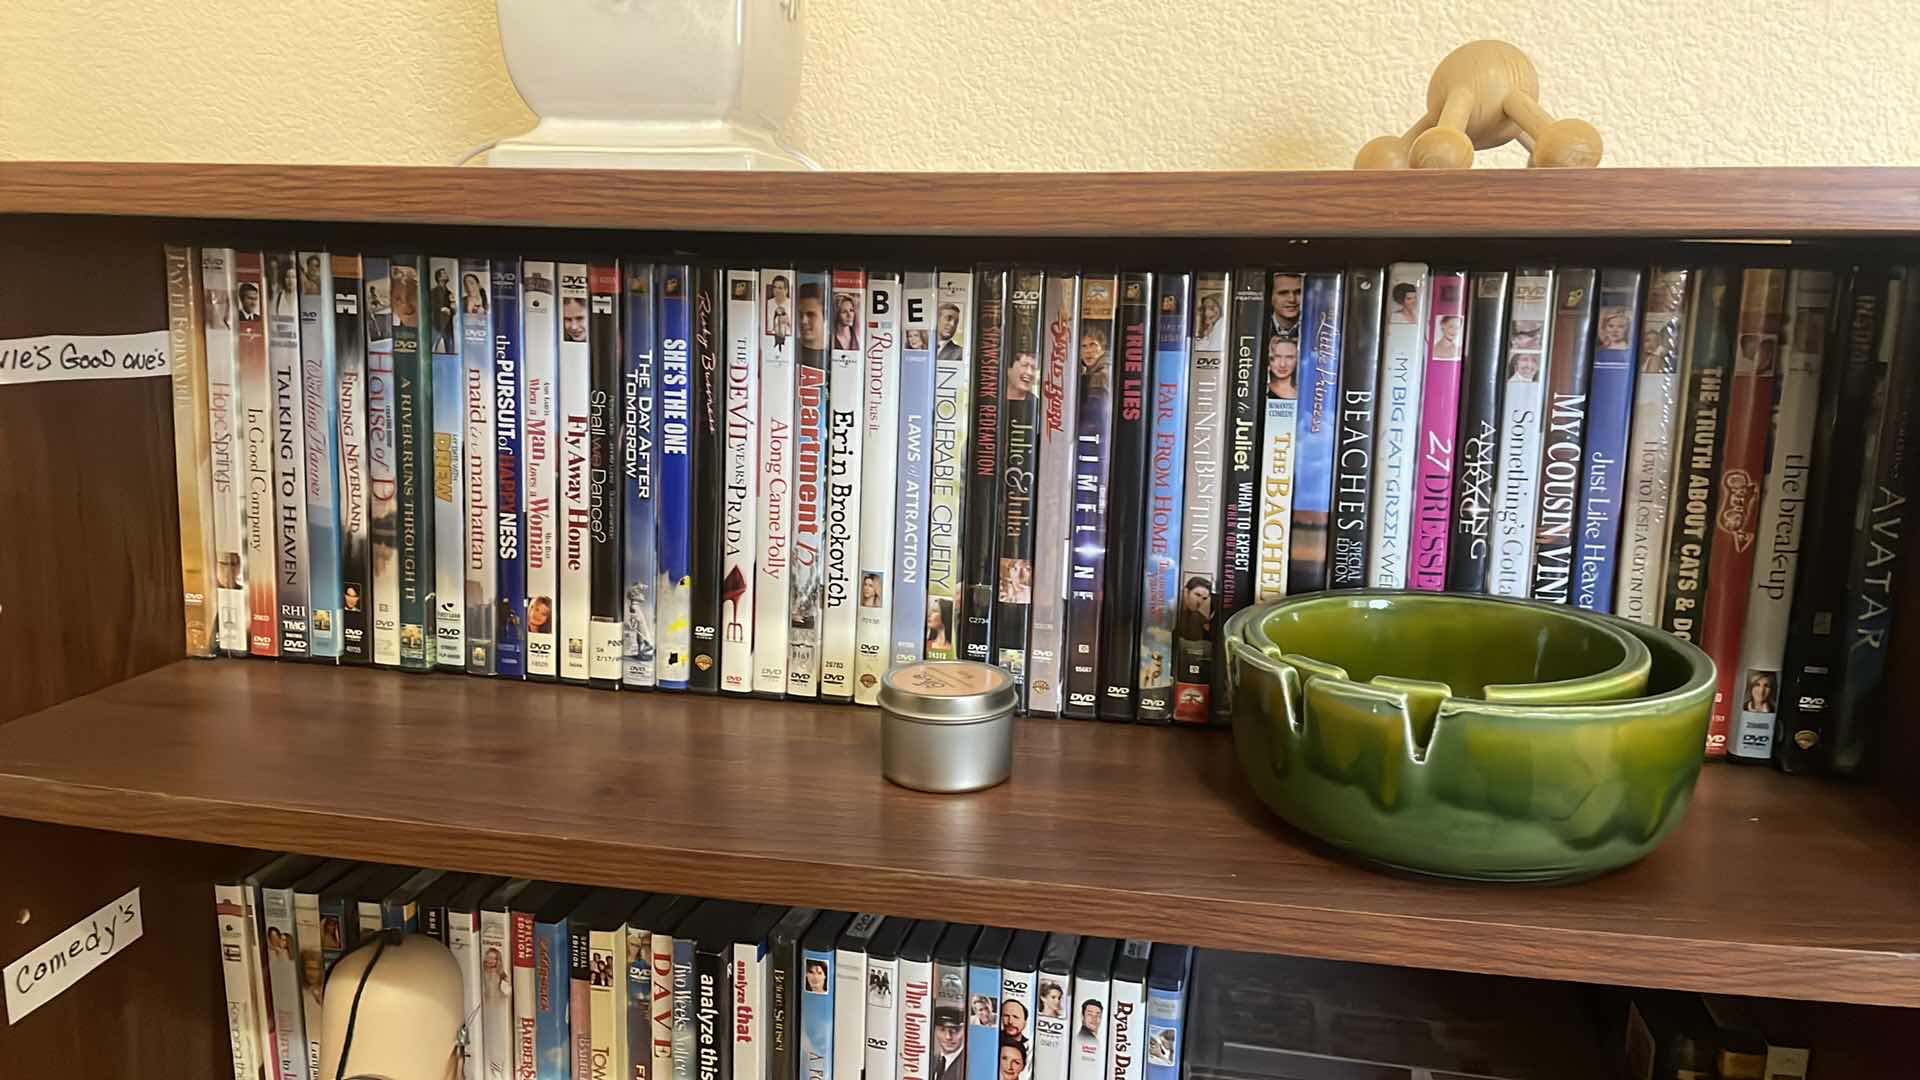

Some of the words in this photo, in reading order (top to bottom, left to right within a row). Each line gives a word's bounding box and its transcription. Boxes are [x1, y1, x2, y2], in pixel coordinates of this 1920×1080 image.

[872, 291, 890, 315] B
[907, 299, 924, 323] E
[496, 335, 510, 360] the
[639, 349, 653, 388] THE
[664, 338, 688, 385] SHE'S
[736, 337, 748, 364] THE
[979, 326, 1001, 398] SHAWSHANK
[1125, 323, 1144, 372] TRUE
[1238, 336, 1256, 398] Letters
[1393, 357, 1409, 383] MY
[211, 381, 231, 431] Hope
[341, 373, 359, 436] FINDING
[369, 351, 393, 440] House
[401, 377, 411, 389] A
[469, 368, 487, 424] maid
[496, 360, 516, 438] PURSUIT
[529, 378, 541, 405] When
[664, 389, 687, 418] THE
[729, 364, 751, 446] DEVIL
[1122, 380, 1143, 421] LIES
[1157, 383, 1178, 425] FAR
[1311, 366, 1337, 433] Princess
[1391, 386, 1408, 421] BIG
[1698, 367, 1723, 401] THE
[247, 408, 263, 423] In
[278, 365, 293, 458] TALKING
[401, 394, 413, 448] RIVER
[565, 415, 589, 448] Fly
[591, 389, 607, 434] Shall
[626, 369, 639, 479] TOMORROW
[639, 397, 653, 433] DAY
[869, 401, 882, 422] has
[932, 366, 958, 496] INTOLERABLE
[1193, 410, 1216, 457] NEXT
[1550, 391, 1587, 435] MY
[249, 427, 267, 472] Good
[371, 447, 389, 472] of
[497, 437, 514, 456] of
[527, 418, 547, 460] Man
[664, 423, 687, 455] ONE
[766, 418, 789, 475] Along
[797, 365, 827, 535] Apartment
[831, 410, 855, 475] Erin
[907, 415, 921, 461] LAWS
[976, 405, 998, 476] REDEMPTION
[1010, 418, 1033, 466] Julie
[1153, 432, 1177, 487] FROM
[1233, 417, 1253, 472] Juliet
[1271, 432, 1293, 473] THE
[1337, 390, 1373, 530] BEACHES
[1387, 428, 1404, 474] FAT
[1426, 431, 1452, 472] 27
[1640, 441, 1660, 477] HOW
[1690, 407, 1718, 469] TRUTH
[212, 432, 233, 493] Springs
[282, 467, 296, 497] TO
[308, 433, 327, 497] Planner
[403, 450, 415, 496] RUNS
[434, 432, 452, 503] DREW
[528, 462, 542, 487] Loves
[565, 453, 588, 504] Away
[639, 437, 653, 499] AFTER
[735, 443, 746, 485] WEARS
[1005, 466, 1034, 494] &
[1194, 460, 1217, 503] BEST
[1496, 408, 1536, 536] Something's
[1589, 451, 1616, 492] Just
[1782, 455, 1809, 493] the
[345, 444, 362, 533] NEVERLAND
[372, 479, 397, 501] D
[591, 468, 608, 543] Dance?
[767, 479, 788, 532] Came
[1238, 482, 1253, 512] WHAT
[1458, 437, 1481, 535] GRACE
[1470, 420, 1497, 560] AMAZING
[1539, 442, 1582, 539] COUSIN
[1638, 478, 1654, 497] TO
[1683, 474, 1710, 540] ABOUT
[249, 477, 268, 552] Company
[471, 453, 488, 569] manhattan
[529, 496, 550, 569] Woman
[726, 484, 747, 557] PRADA
[903, 480, 921, 583] ATTRACTION
[1005, 491, 1031, 538] Julia
[1074, 434, 1099, 600] TIMELINE
[1151, 496, 1173, 554] HOME
[1189, 505, 1211, 560] THING
[1226, 503, 1238, 528] WHEN
[1237, 517, 1251, 529] TO
[1584, 498, 1611, 539] Like
[1634, 499, 1654, 534] LOSE
[283, 505, 297, 585] HEAVEN
[404, 501, 416, 582] THROUGH
[567, 506, 590, 570] Home
[763, 535, 786, 579] Polly
[828, 484, 853, 609] Brockovich
[930, 504, 953, 590] CRUELTY
[1235, 534, 1250, 572] EXPECT
[1335, 537, 1350, 583] EDITION
[1347, 540, 1363, 581] SPECIAL
[1631, 545, 1650, 577] GUY
[1758, 498, 1806, 601] break-up
[1498, 540, 1525, 595] Gotta
[1630, 577, 1644, 592] IN
[1676, 543, 1702, 592] CATS
[1849, 486, 1906, 652] AVATAR
[282, 605, 306, 617] RHI
[405, 586, 416, 604] IT
[1674, 597, 1696, 612] &
[283, 621, 307, 631] TMG
[16, 903, 136, 994] Comedy's
[517, 917, 526, 960] EDITION
[526, 919, 534, 959] SPECIAL
[572, 934, 580, 968] EDITION
[580, 935, 588, 968] SPECIAL
[674, 962, 692, 989] Two
[735, 960, 747, 1004] analyze
[904, 982, 929, 1008] The
[654, 952, 672, 1059] DAVE
[674, 991, 692, 1032] Weeks
[696, 975, 718, 1045] analyze
[737, 1005, 753, 1042] that
[1114, 1001, 1134, 1052] Ryan's
[700, 1048, 718, 1080] this
[899, 1012, 928, 1073] Goodbye
